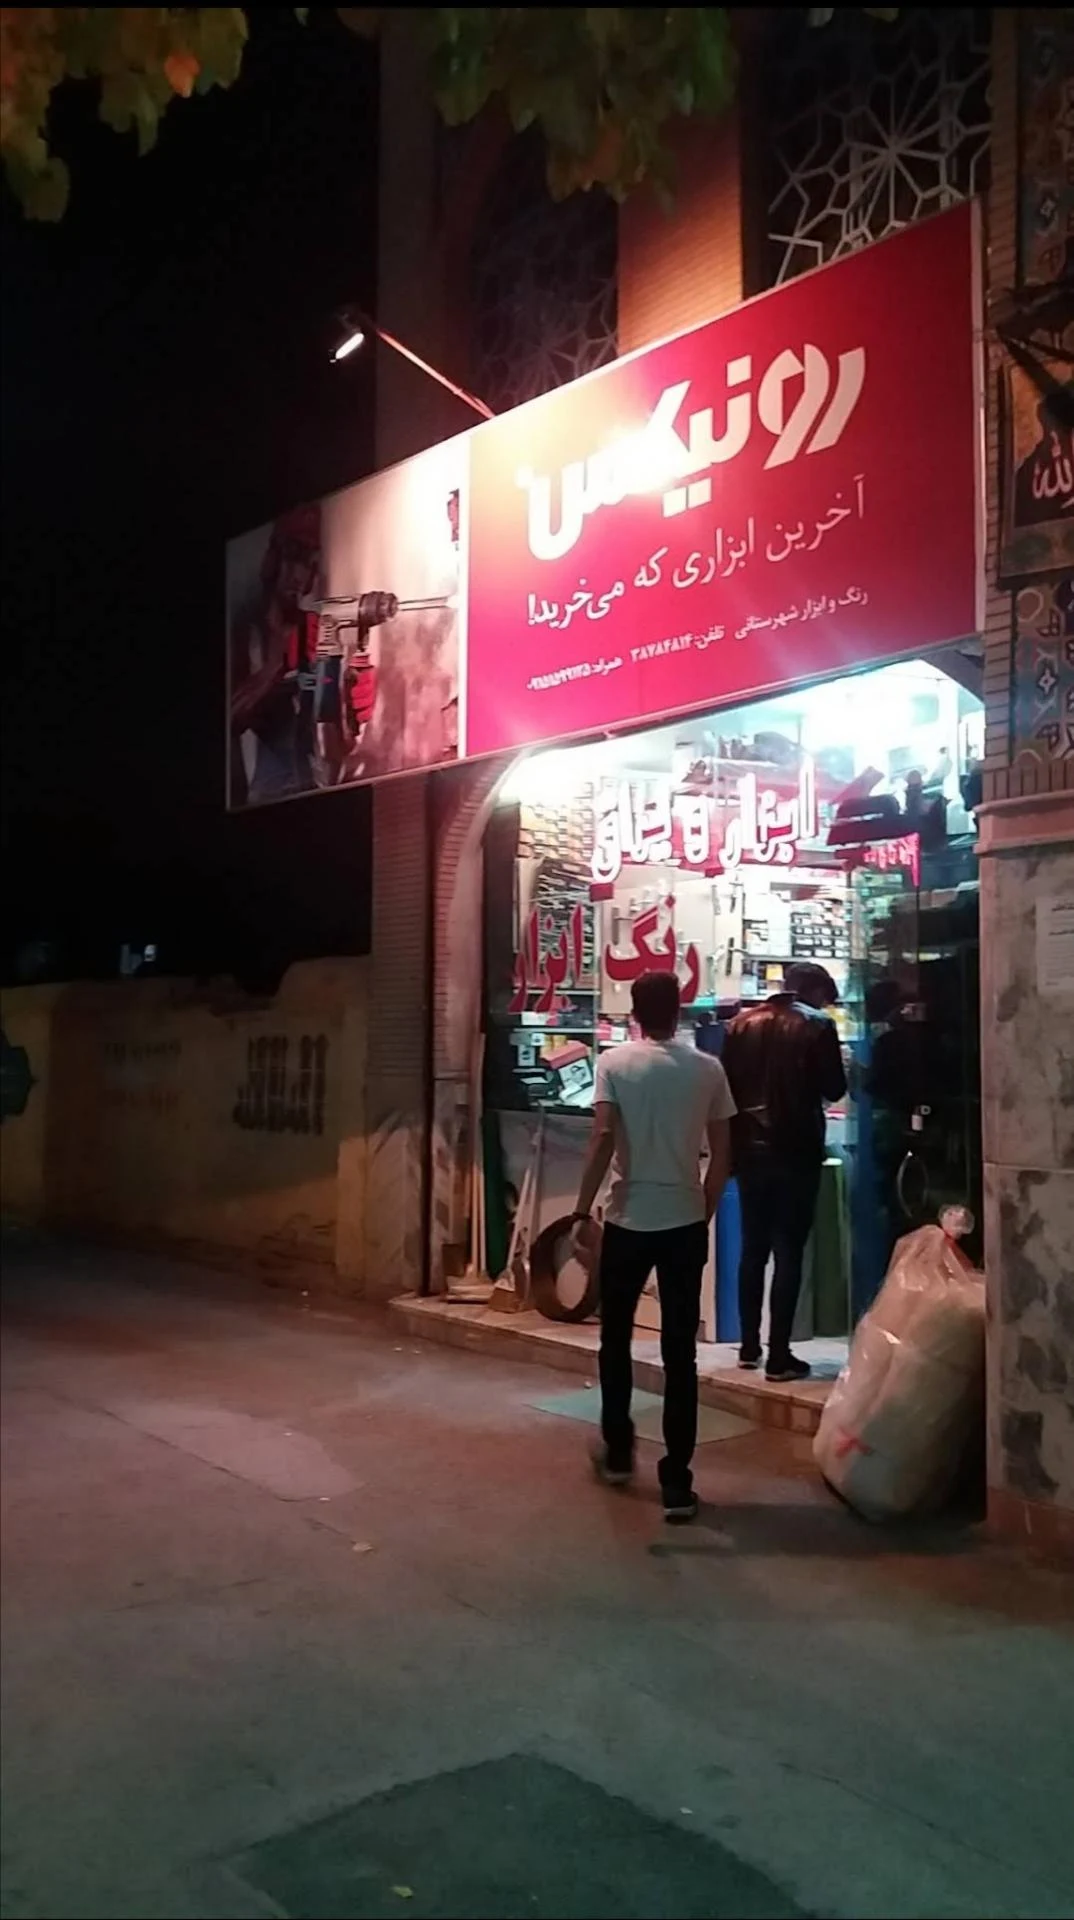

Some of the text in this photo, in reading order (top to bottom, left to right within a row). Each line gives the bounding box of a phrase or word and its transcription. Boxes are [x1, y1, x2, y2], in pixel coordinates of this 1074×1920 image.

[526, 343, 866, 561] رونیکس
[672, 516, 755, 588] ابزاری
[766, 474, 865, 562] آخرین
[633, 546, 669, 588] که
[838, 586, 868, 605] رنگ
[734, 605, 799, 640] شهرستانی
[718, 752, 817, 868] ابزار
[605, 894, 699, 1003] رنگ
